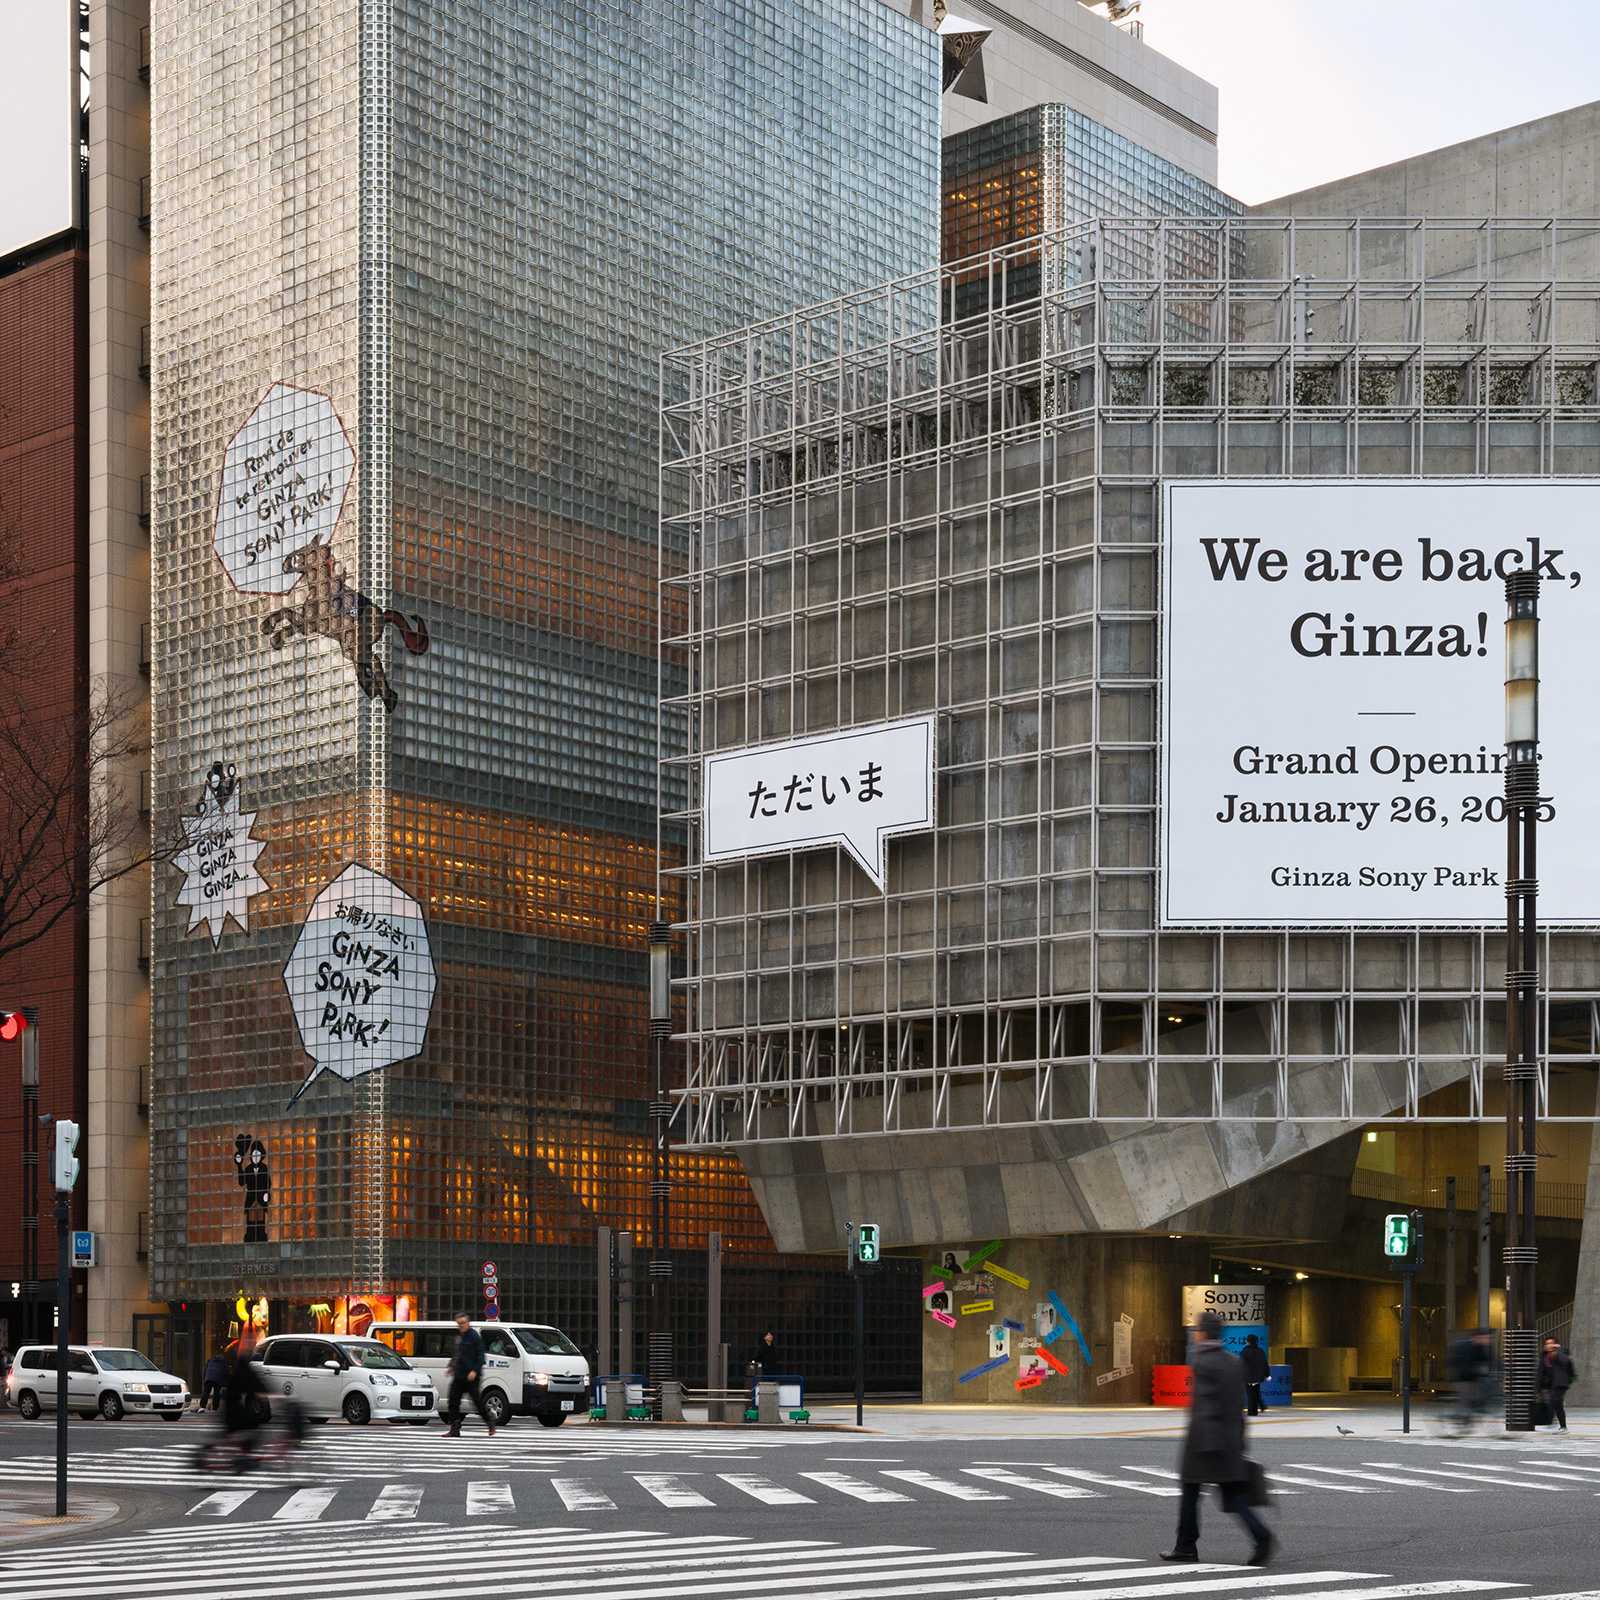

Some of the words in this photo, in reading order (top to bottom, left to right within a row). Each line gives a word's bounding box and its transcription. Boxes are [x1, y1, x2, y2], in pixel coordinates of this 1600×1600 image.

[236, 492, 251, 509] te
[250, 436, 313, 498] retrouver
[244, 439, 275, 475] Ravi
[277, 428, 295, 451] de
[257, 472, 307, 521] GINZA
[244, 518, 287, 567] SONY
[290, 474, 334, 528] PARK!
[1199, 537, 1288, 582] We
[1304, 547, 1404, 582] are
[1418, 537, 1582, 589] back,
[1290, 612, 1488, 658] Ginza!
[1232, 745, 1359, 775] Grand
[1369, 745, 1543, 782] Openin
[748, 762, 883, 819] ただいま
[1216, 794, 1380, 830] January
[1390, 796, 1449, 827] 26,
[1461, 796, 1556, 823] 205
[196, 827, 234, 858] GINZA
[199, 848, 237, 879] GINZA
[1271, 866, 1351, 888] Ginza
[1359, 866, 1427, 892] Sony
[1434, 867, 1500, 887] Park
[334, 901, 415, 952] お帰りなさい
[332, 931, 400, 981] GINZA
[314, 961, 381, 1005] SONY
[320, 1001, 390, 1048] PARK!
[486, 1287, 496, 1296] 30
[1204, 1290, 1249, 1307] Sony
